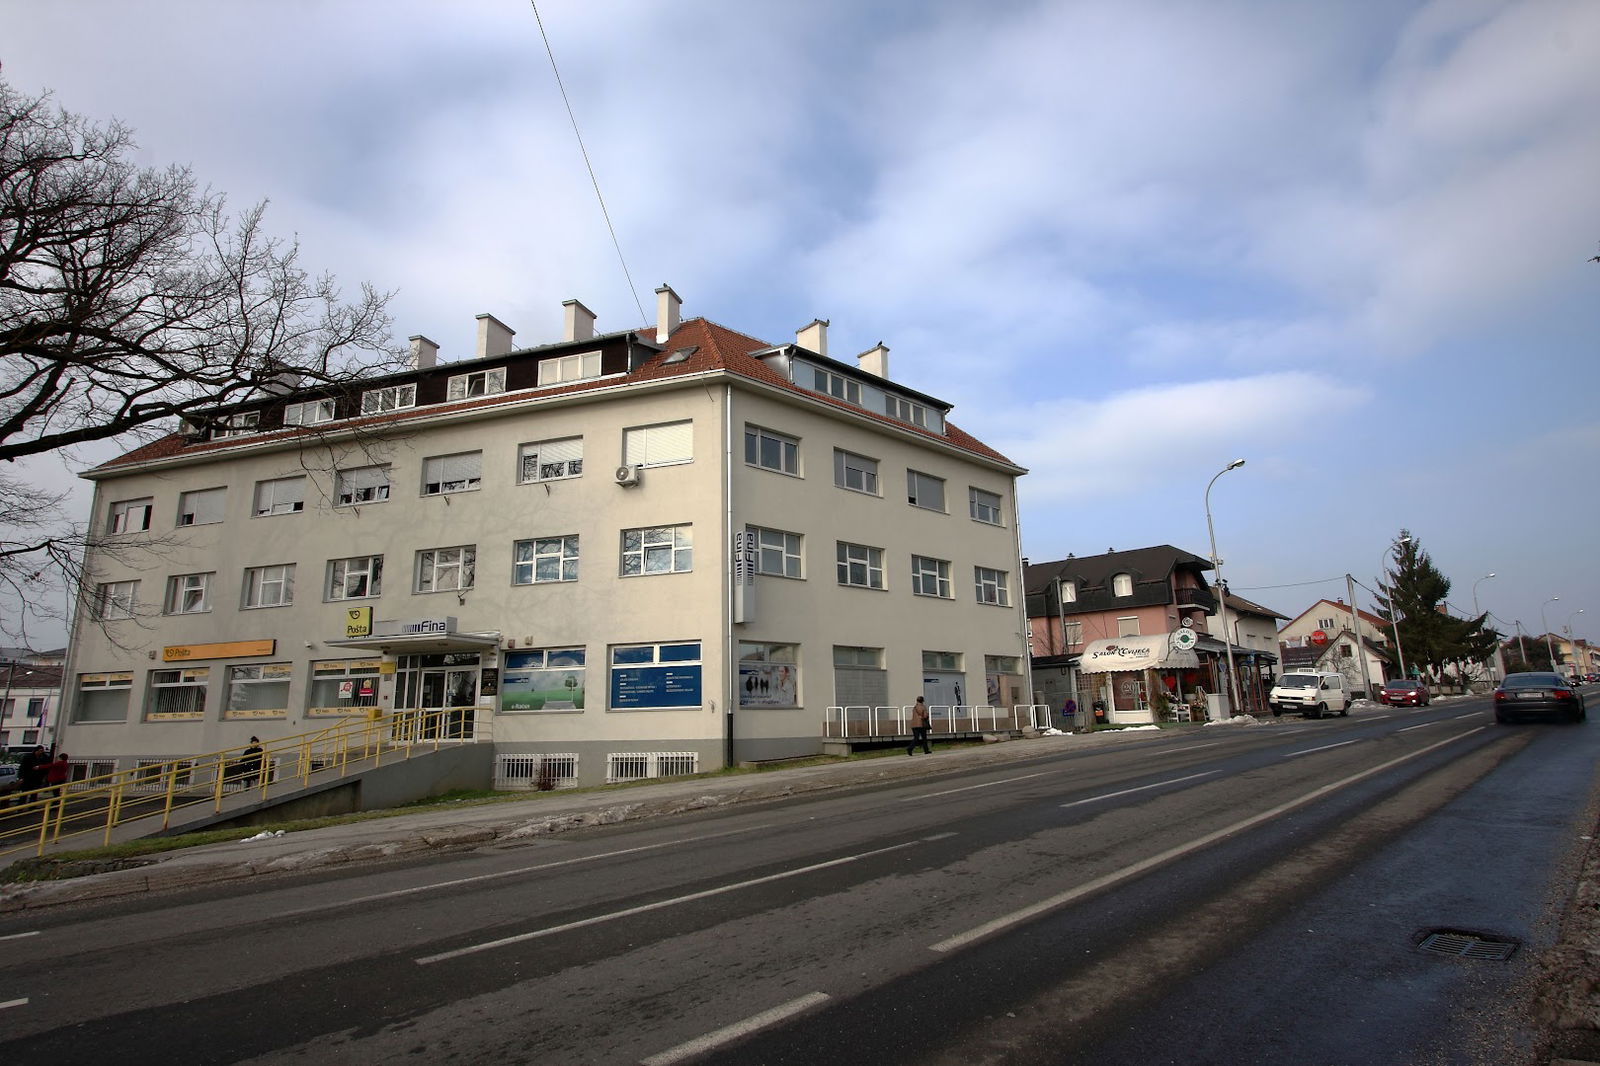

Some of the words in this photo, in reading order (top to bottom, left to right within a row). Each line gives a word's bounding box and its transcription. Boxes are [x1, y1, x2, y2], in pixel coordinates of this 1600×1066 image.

[735, 533, 743, 563] Fina
[745, 533, 754, 563] Fina
[347, 625, 367, 634] Pošta
[421, 621, 446, 632] Fina
